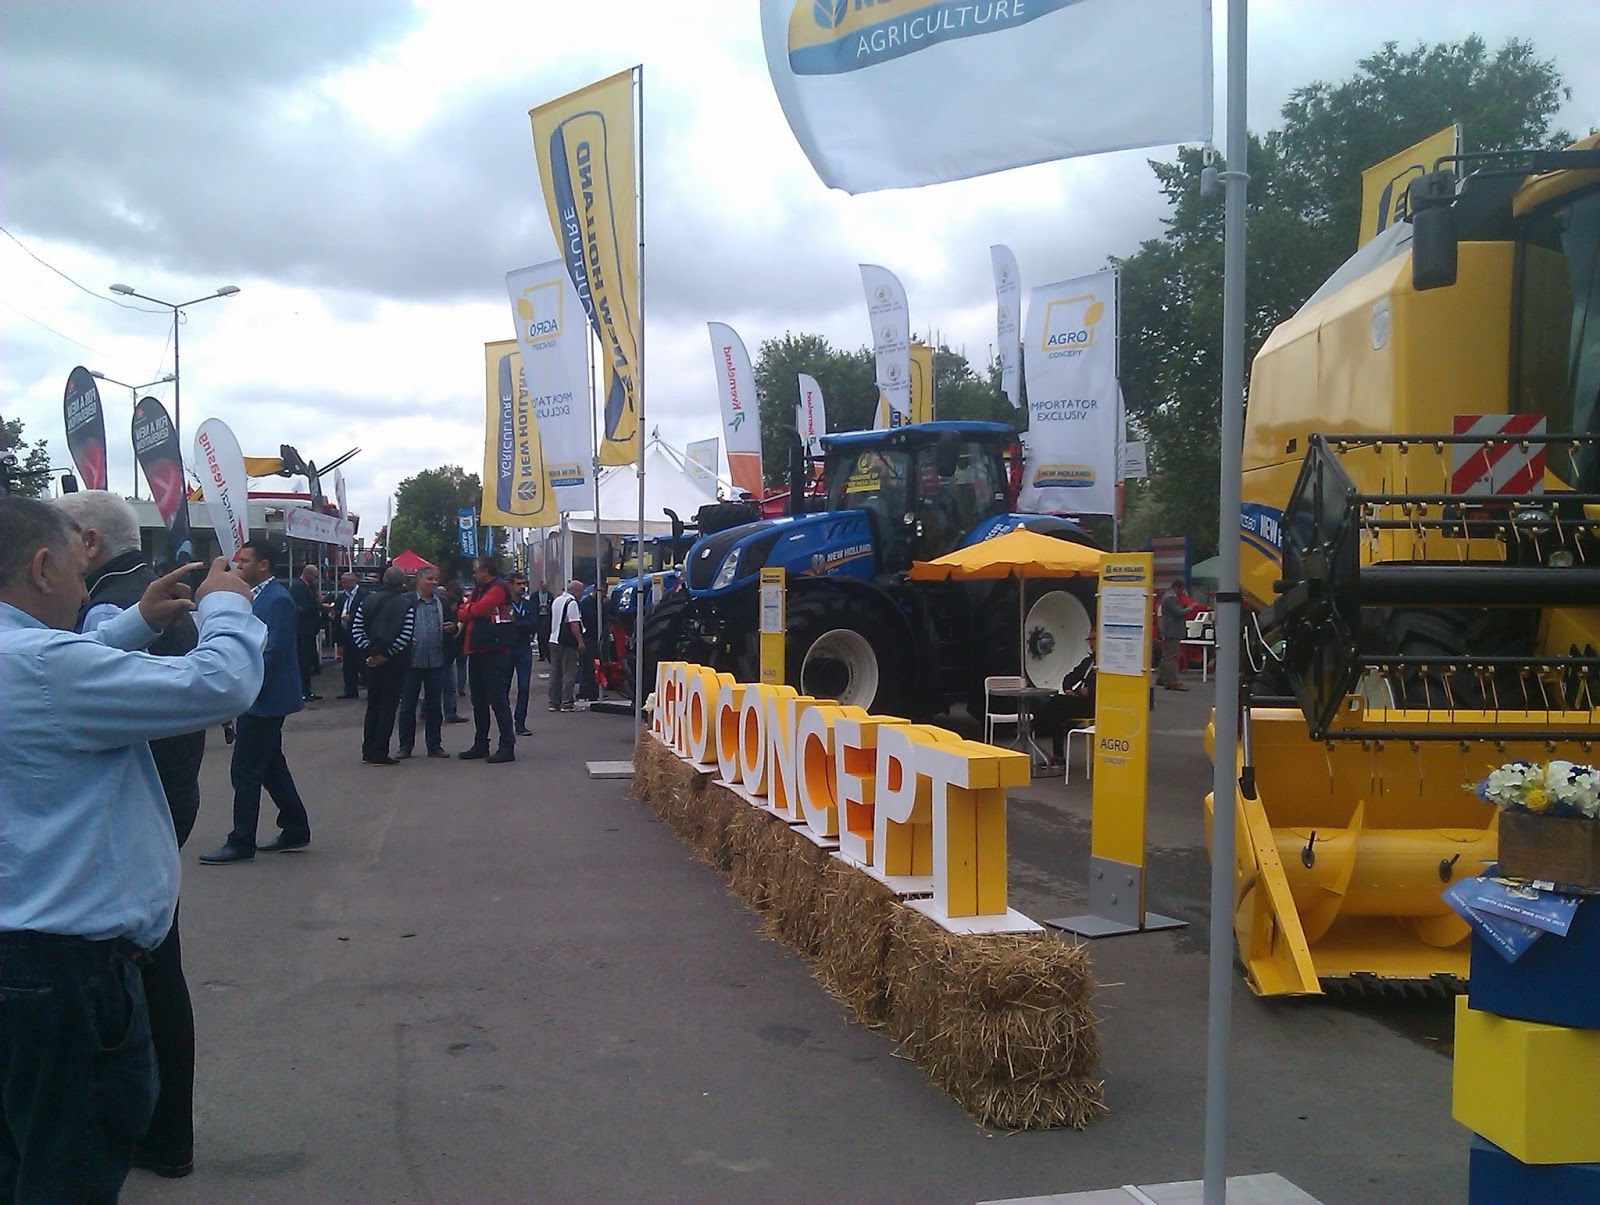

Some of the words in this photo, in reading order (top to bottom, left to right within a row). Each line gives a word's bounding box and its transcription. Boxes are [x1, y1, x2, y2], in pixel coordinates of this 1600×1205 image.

[856, 0, 1025, 58] AGRICULTURE
[1048, 331, 1088, 346] AGRO
[1049, 350, 1082, 359] CONCEPT
[1031, 400, 1098, 411] MPORTATOR
[1037, 411, 1087, 421] EXCLUSIV
[1260, 514, 1278, 544] NEW
[827, 550, 844, 562] NEW
[844, 544, 872, 557] HOLLAND
[1100, 738, 1129, 752] AGRO
[652, 661, 720, 765] AGRO
[716, 683, 1025, 918] CONCEPT
